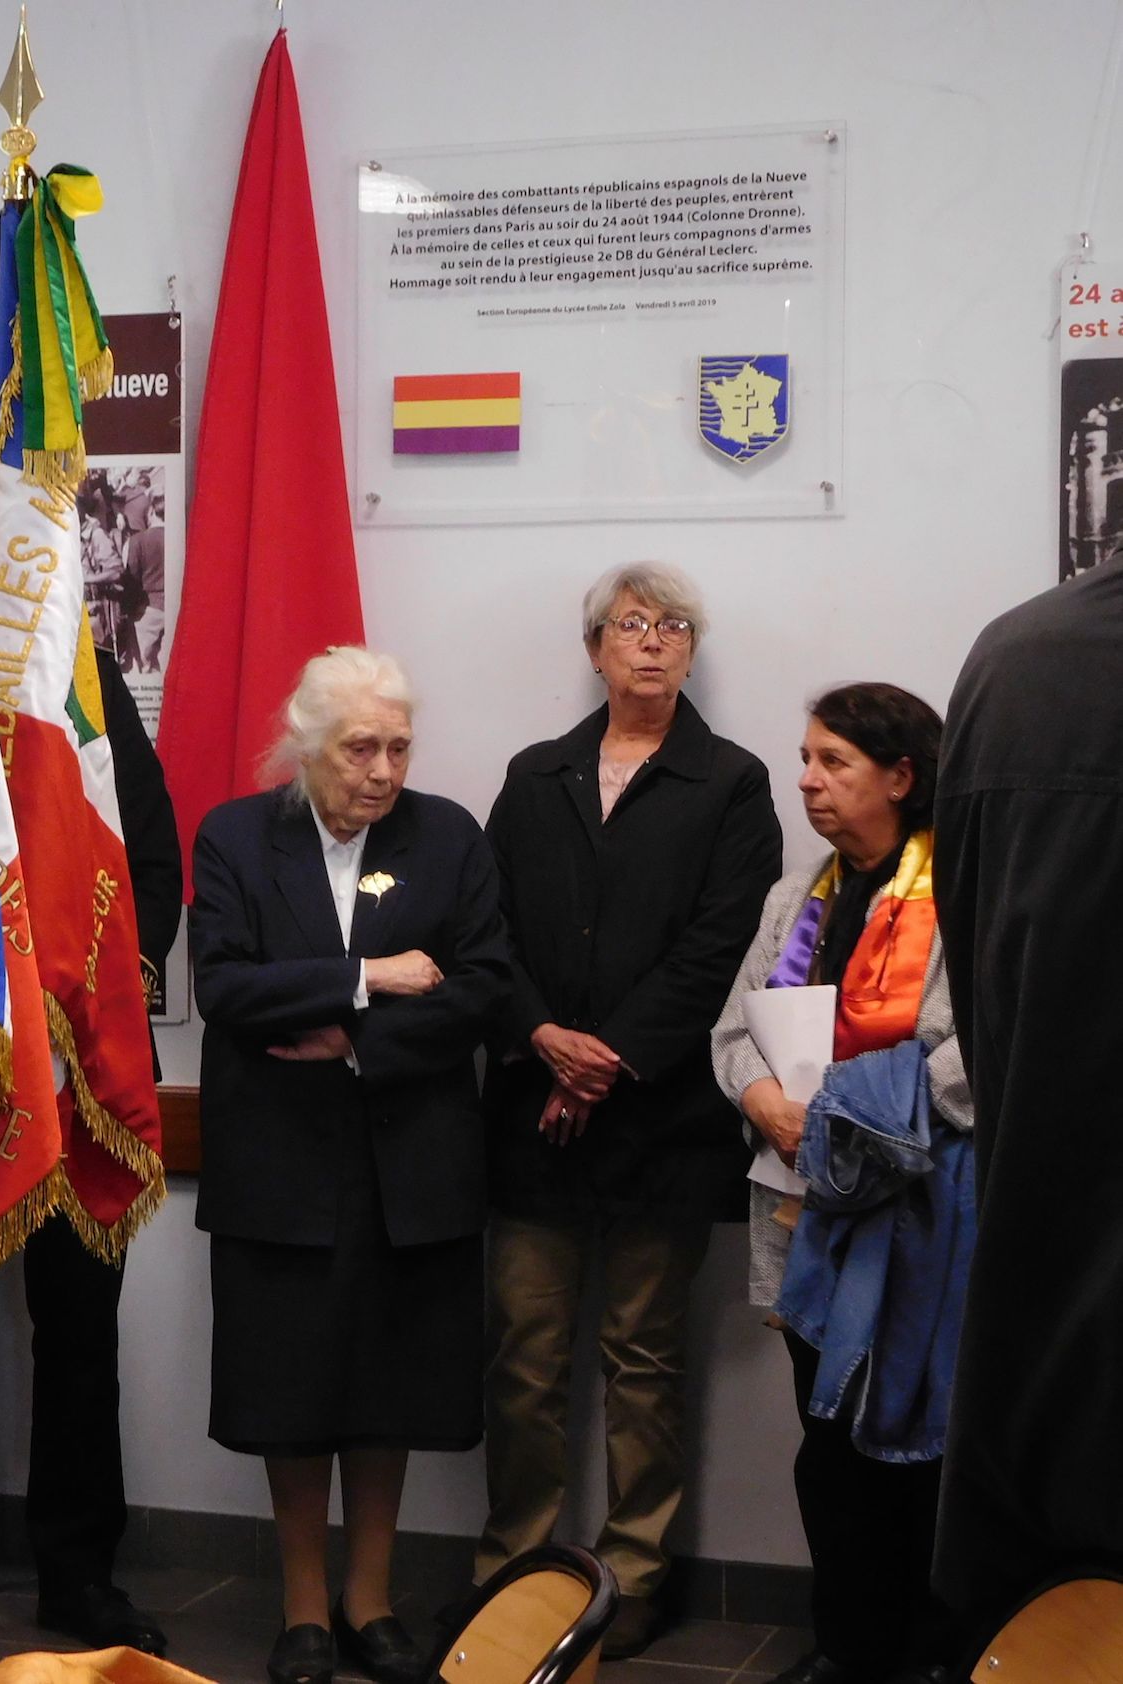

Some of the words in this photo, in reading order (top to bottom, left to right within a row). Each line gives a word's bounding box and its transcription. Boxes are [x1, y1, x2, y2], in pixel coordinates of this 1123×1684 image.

[406, 191, 417, 204] la
[420, 189, 474, 203] mémoire
[477, 187, 498, 200] des
[501, 184, 579, 198] combattants
[582, 178, 660, 196] républicains
[663, 174, 728, 191] espagnols
[731, 173, 748, 185] de
[750, 172, 762, 184] la
[765, 171, 807, 184] Nueve
[406, 206, 428, 222] qui,
[432, 203, 498, 218] inlassables
[501, 201, 569, 214] défenseurs
[572, 198, 588, 211] de
[591, 197, 601, 210] la
[605, 195, 647, 209] liberté
[650, 194, 672, 207] des
[675, 192, 729, 208] peuples,
[732, 189, 793, 202] entrèrent
[397, 226, 412, 238] les
[416, 223, 469, 240] premiers
[473, 222, 501, 234] dans
[505, 219, 534, 232] Paris
[538, 221, 552, 231] au
[556, 216, 578, 230] soir
[582, 216, 598, 228] du
[602, 215, 616, 227] 24
[620, 213, 648, 226] août
[654, 211, 683, 224] 1944
[687, 209, 744, 224] (Colonne
[748, 204, 804, 219] Dronne).
[390, 240, 398, 255] À
[401, 242, 412, 255] la
[415, 240, 469, 254] mémoire
[472, 239, 487, 251] de
[490, 237, 524, 250] celles
[527, 237, 539, 248] et
[542, 237, 571, 247] ceux
[574, 233, 594, 248] qui
[597, 232, 636, 245] furent
[639, 230, 670, 242] leurs
[673, 227, 756, 242] compagnons
[759, 223, 811, 236] d'armes
[439, 260, 455, 270] au
[458, 256, 482, 269] sein
[485, 255, 501, 268] de
[503, 254, 514, 267] la
[517, 251, 594, 269] prestigieuse
[597, 251, 612, 262] 2e
[615, 248, 633, 261] DB
[636, 248, 652, 260] du
[655, 245, 706, 259] Général
[709, 243, 757, 257] Leclerc.
[389, 276, 452, 289] Hommage
[454, 273, 477, 286] soit
[479, 271, 516, 285] rendu
[518, 270, 526, 283] à
[529, 270, 554, 282] leur
[556, 267, 636, 283] engagement
[638, 263, 693, 280] jusqu'au
[695, 260, 749, 274] sacrifice
[751, 258, 813, 273] suprême.
[477, 309, 505, 317] Section
[506, 307, 551, 316] Européenne
[564, 305, 585, 314] Lycée
[609, 303, 626, 311] Zola
[698, 299, 717, 307] 2019
[1069, 283, 1102, 305] 24
[1068, 318, 1108, 338] est
[105, 373, 169, 398] ueve
